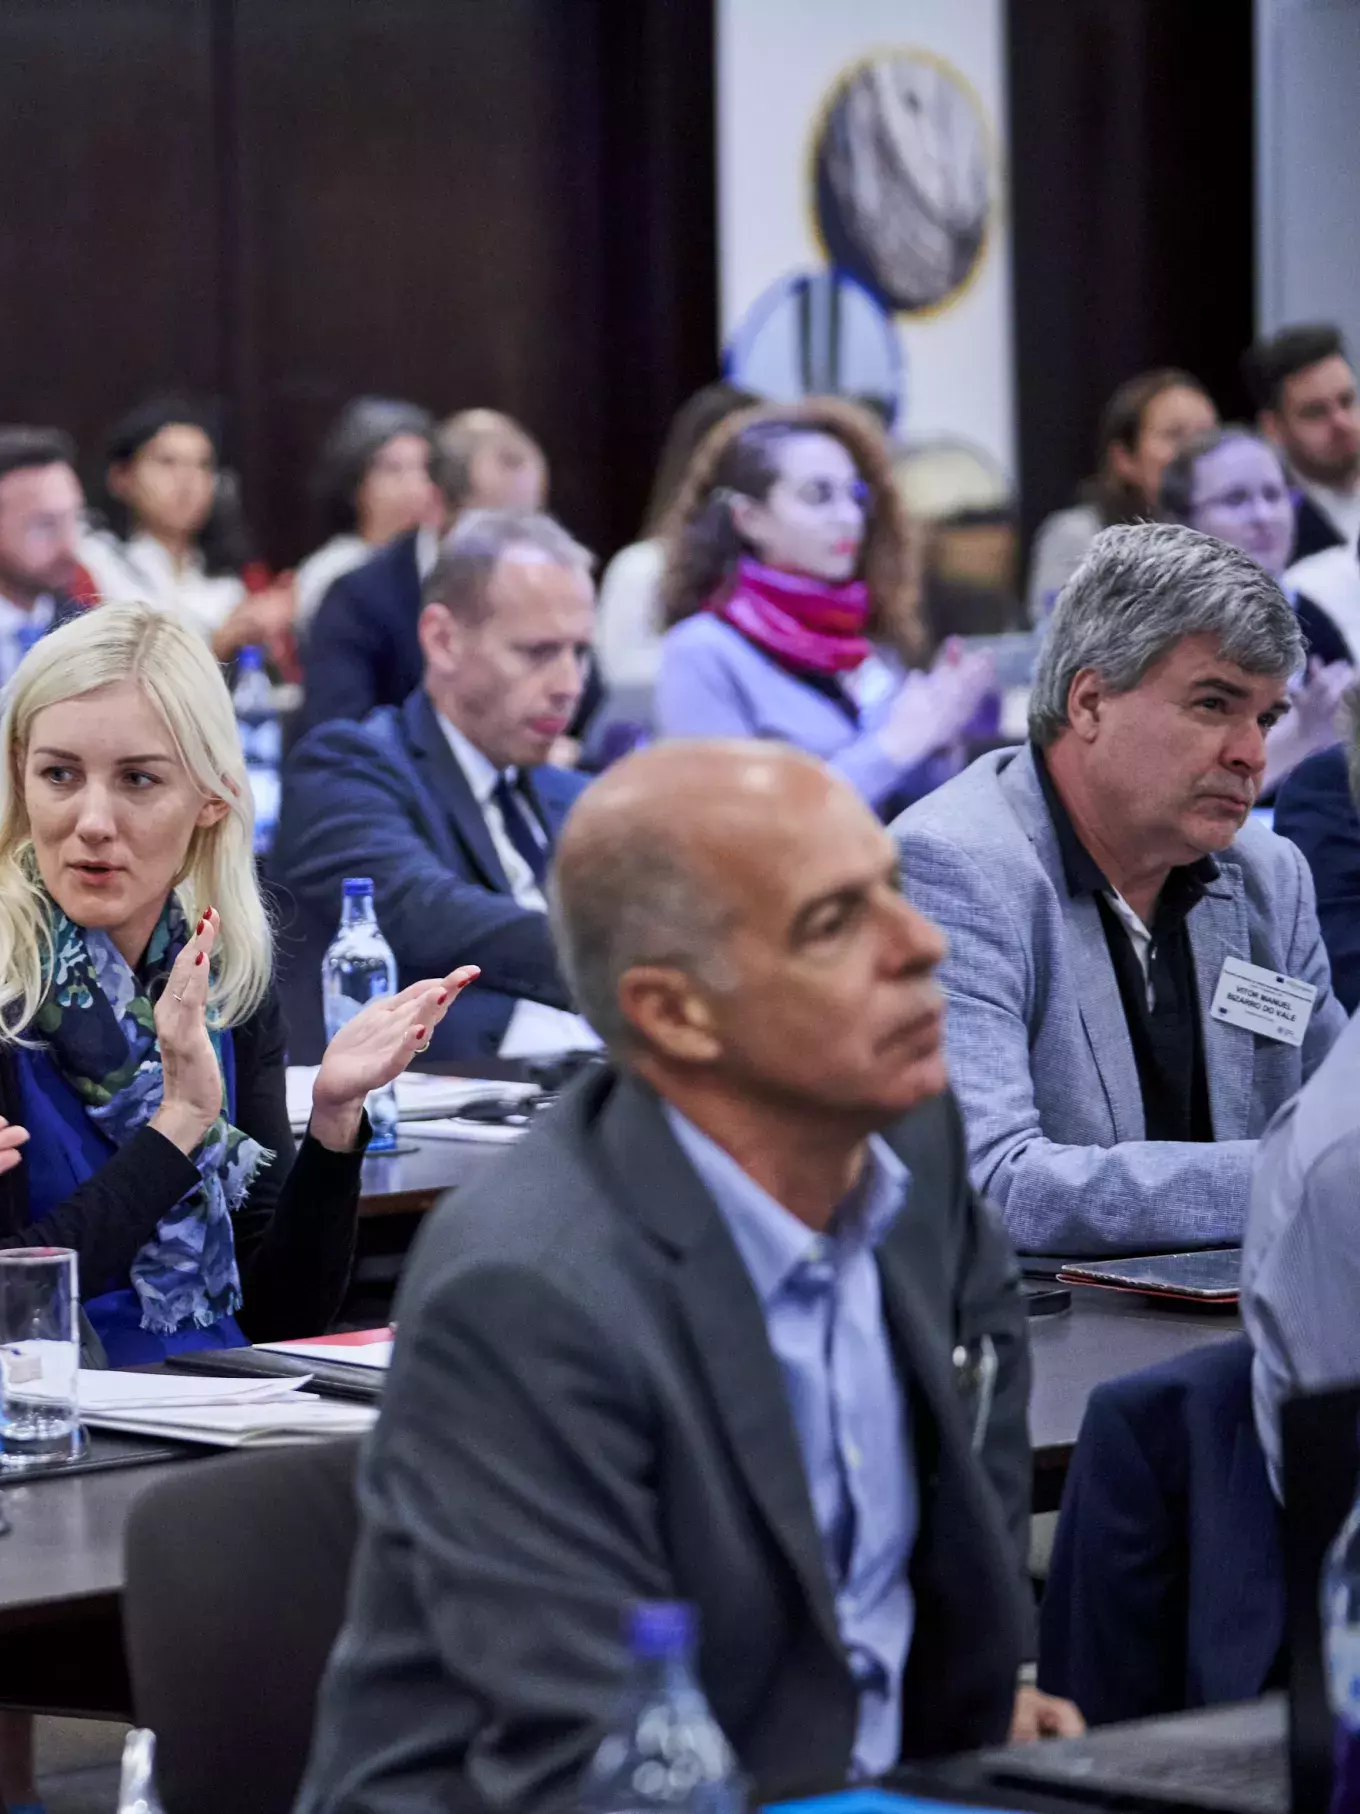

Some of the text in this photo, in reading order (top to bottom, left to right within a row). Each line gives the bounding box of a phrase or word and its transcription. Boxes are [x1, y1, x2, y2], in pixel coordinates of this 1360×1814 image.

[1227, 992, 1261, 1010] BIZARRO
[1262, 1004, 1274, 1015] DO
[1276, 1010, 1297, 1022] VALE
[1236, 985, 1259, 998] VITOR
[1260, 993, 1292, 1011] MANUEL
